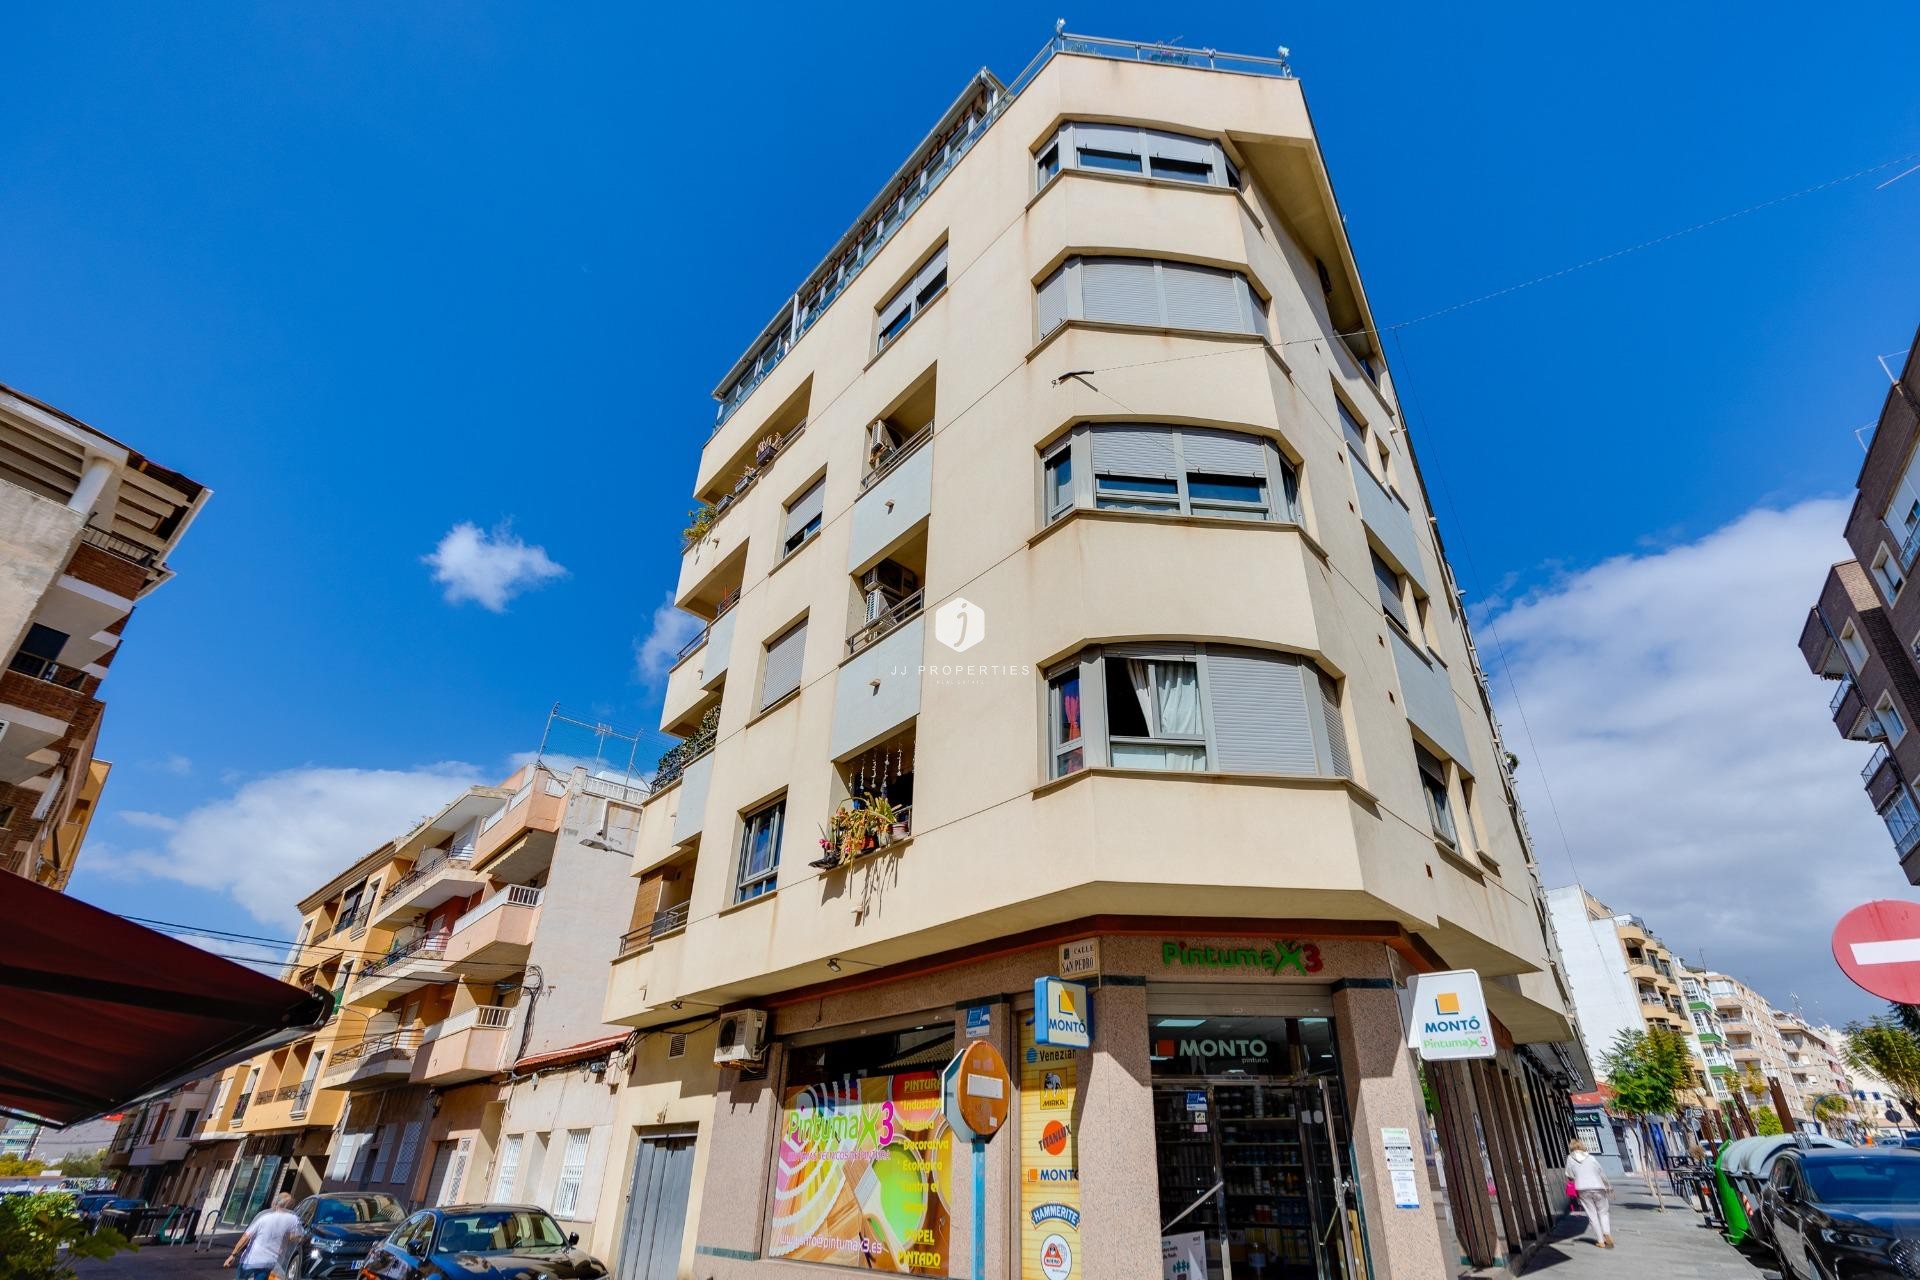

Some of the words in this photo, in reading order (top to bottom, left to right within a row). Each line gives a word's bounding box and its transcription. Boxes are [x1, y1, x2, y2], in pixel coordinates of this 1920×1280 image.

[1073, 944, 1094, 955] CALLE
[1062, 960, 1074, 974] SAN
[1075, 957, 1094, 972] PEDRO
[1425, 1015, 1480, 1033] MONTÓ
[1042, 1099, 1066, 1108] MIRKA
[903, 1139, 949, 1151] Decorativa
[1038, 1124, 1072, 1152] TITANLUX
[1033, 1205, 1078, 1225] HAMMERITE
[898, 1250, 941, 1267] PINTADO
